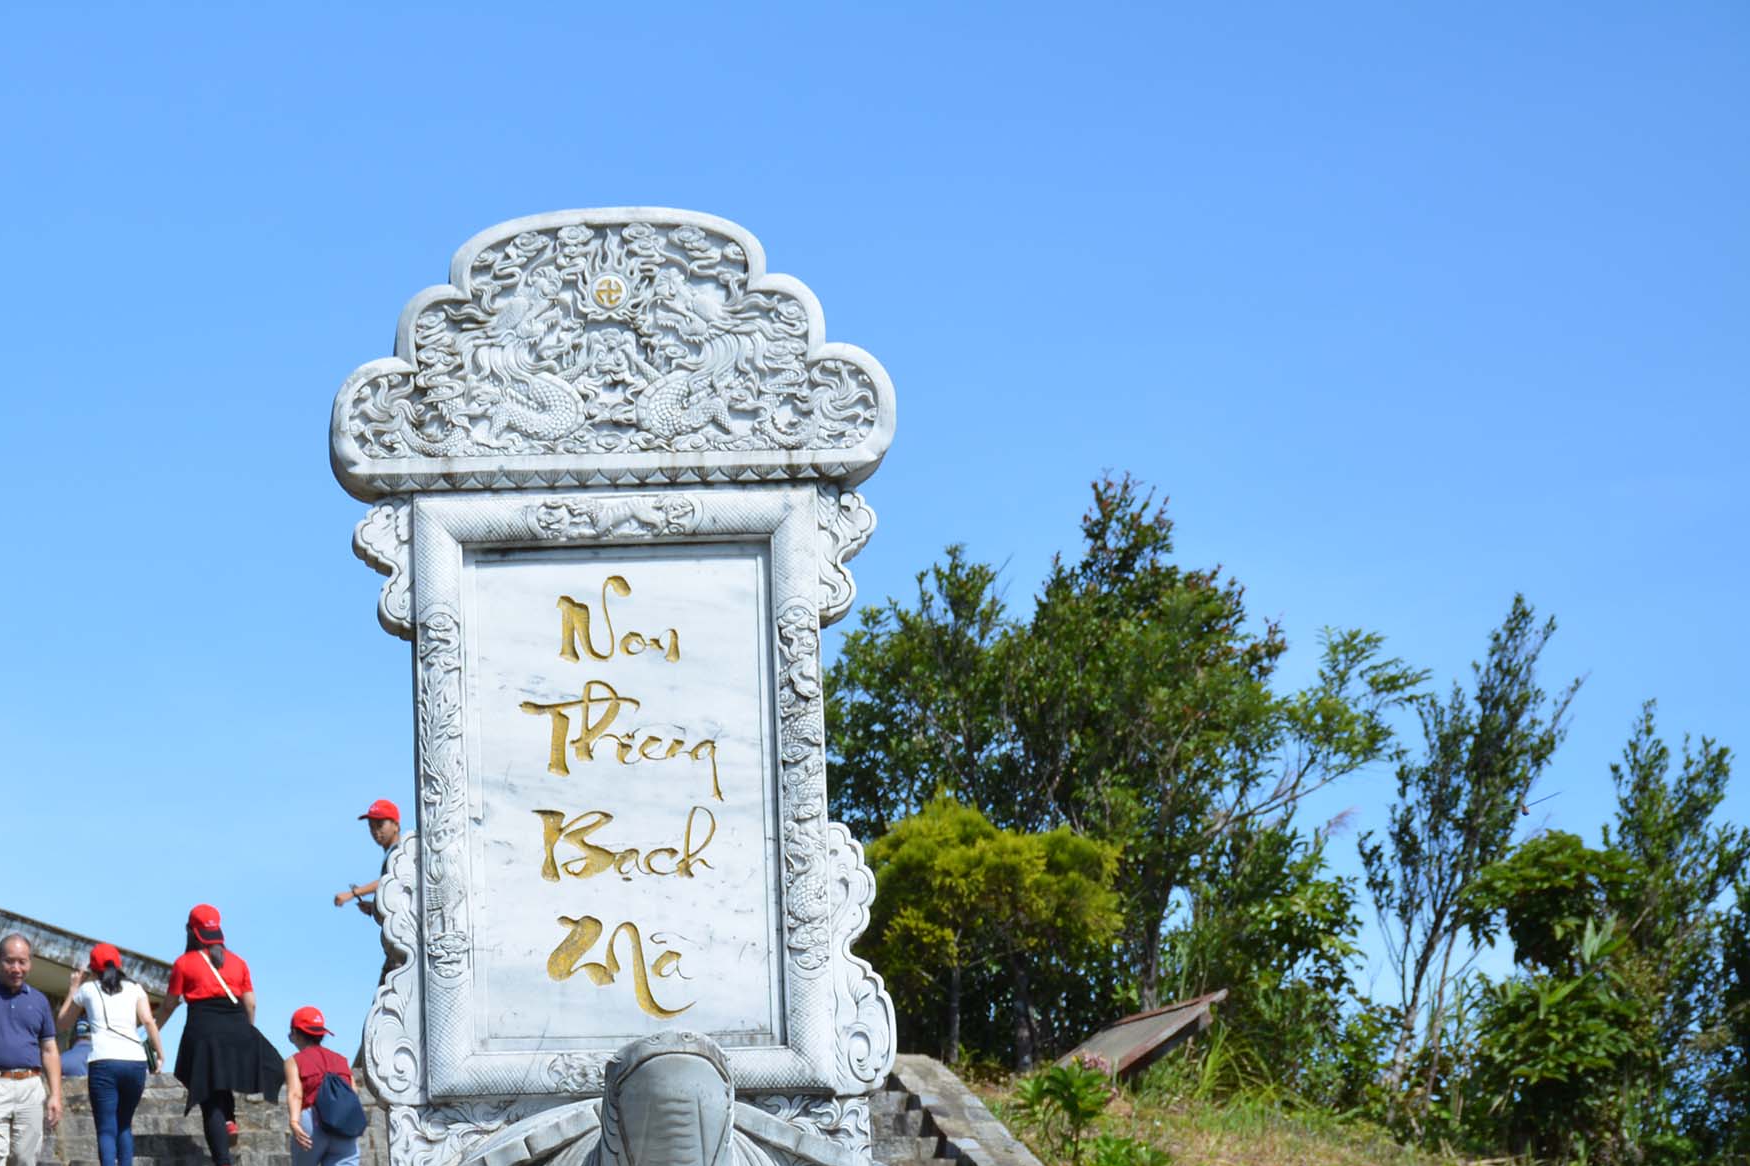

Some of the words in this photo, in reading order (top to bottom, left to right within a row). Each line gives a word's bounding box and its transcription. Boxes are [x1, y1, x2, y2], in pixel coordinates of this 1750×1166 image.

[556, 575, 680, 664] Non
[531, 806, 716, 882] Bạch
[547, 915, 702, 1020] Mã
